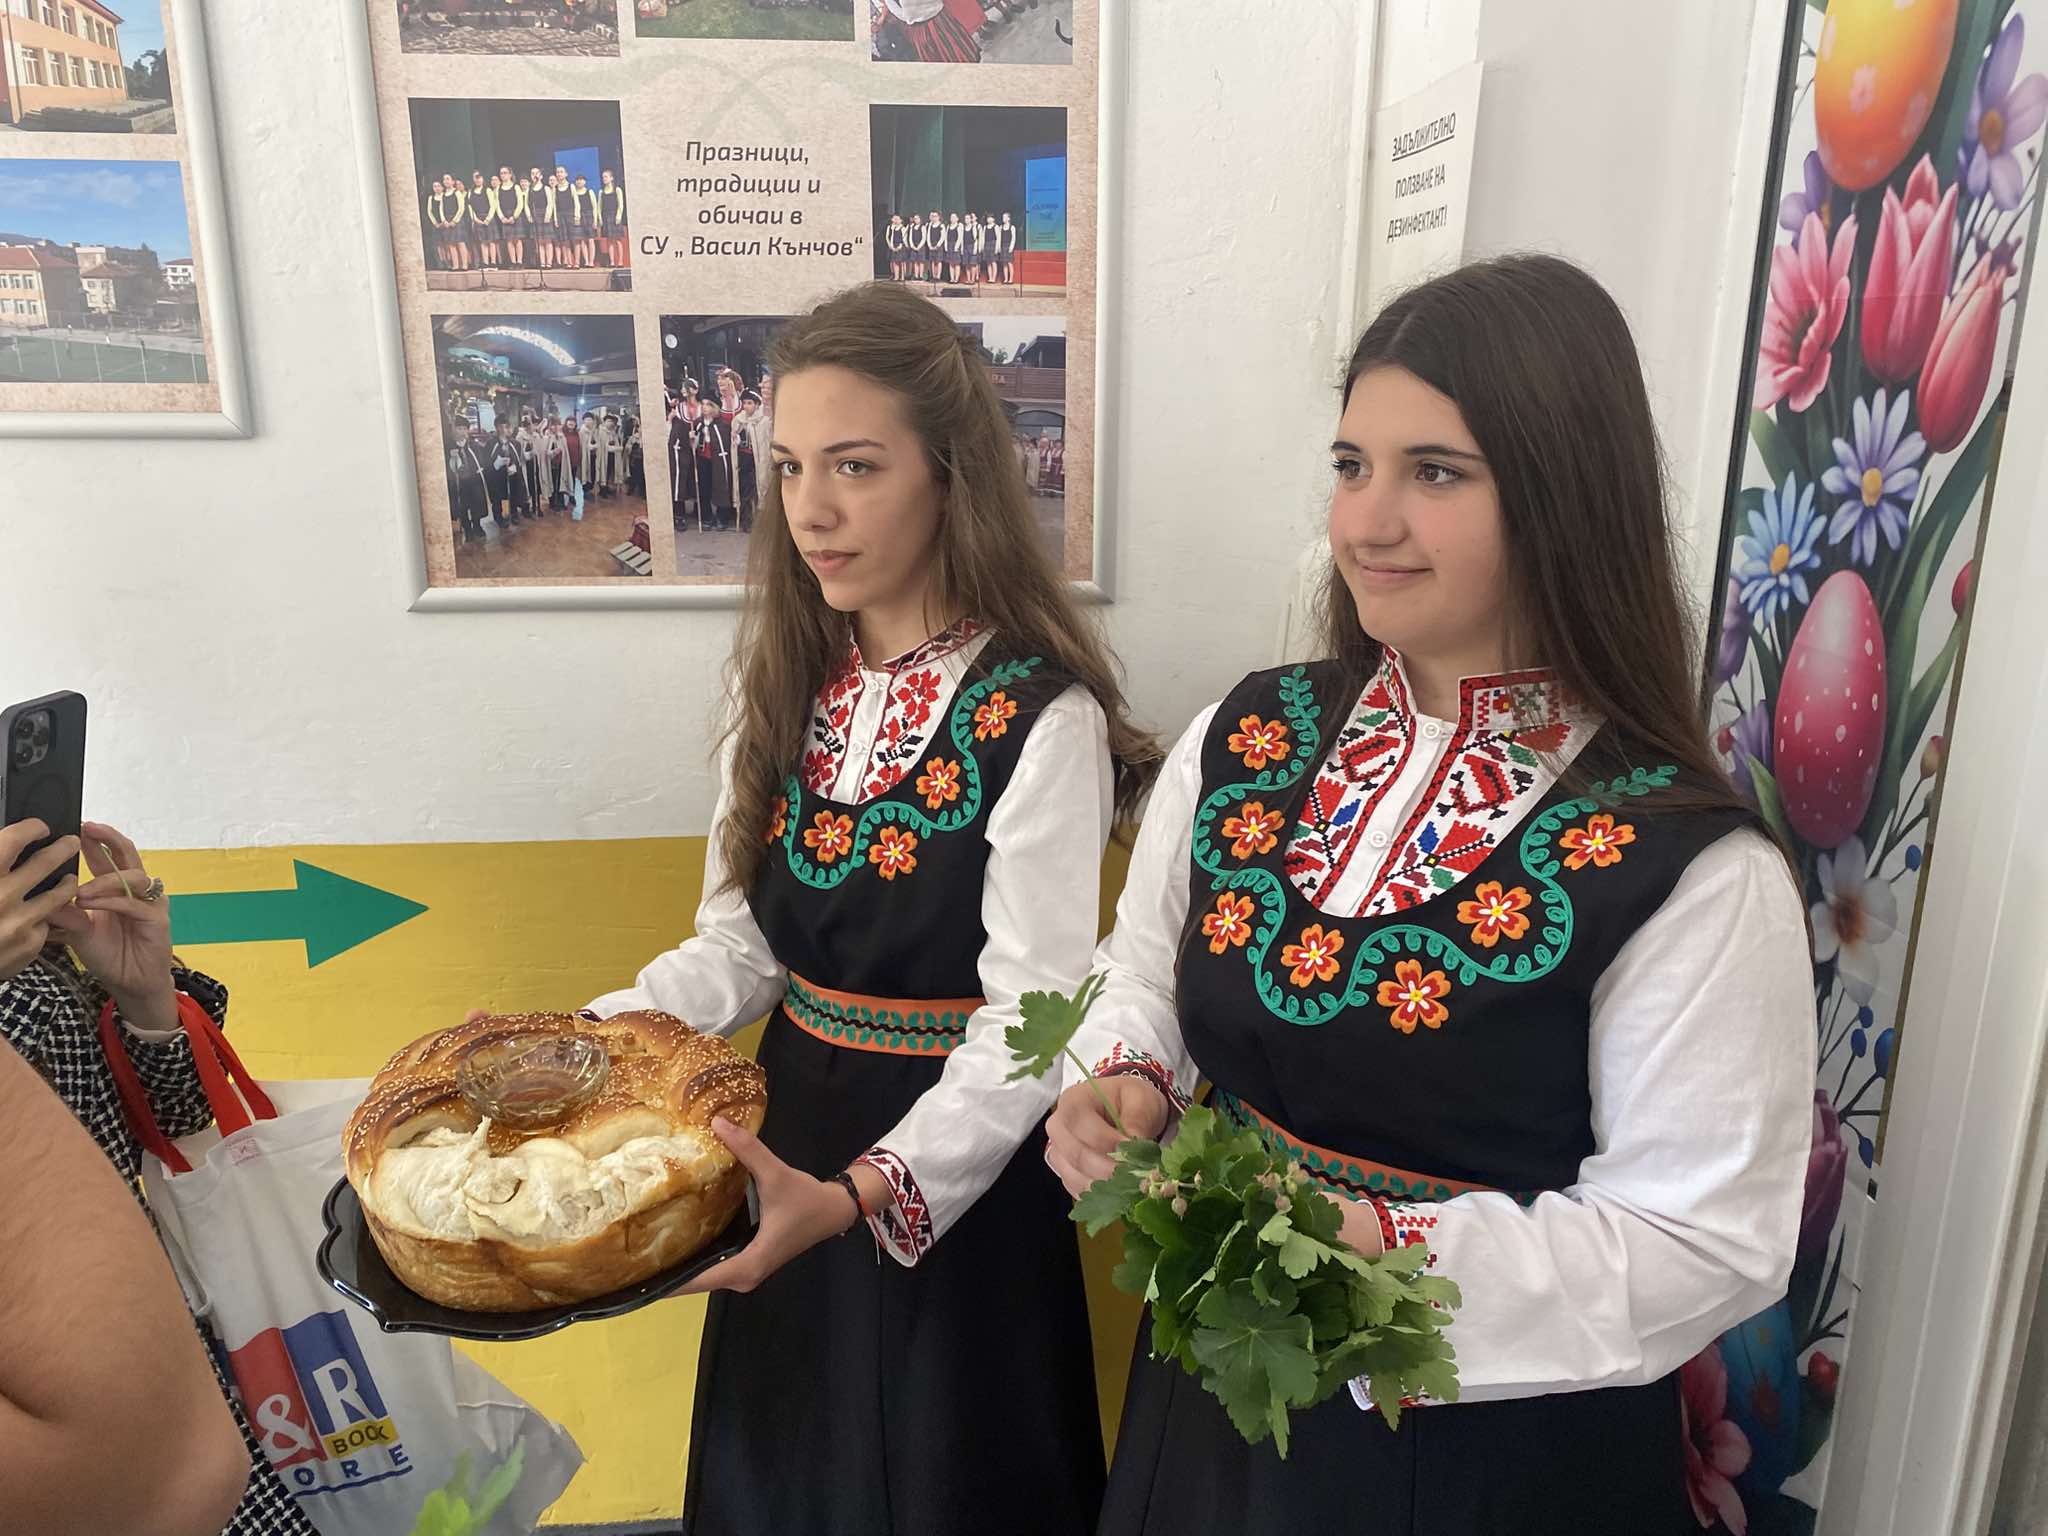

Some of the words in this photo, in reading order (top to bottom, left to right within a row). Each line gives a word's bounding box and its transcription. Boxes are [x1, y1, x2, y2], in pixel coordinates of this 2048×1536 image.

[686, 141, 809, 166] Празници,
[676, 173, 801, 197] традиции
[808, 179, 821, 193] и
[1395, 168, 1433, 199] ПОЛЗВАНЕ
[1434, 163, 1446, 187] НА
[698, 205, 783, 224] обичаи
[790, 210, 803, 224] в
[1386, 204, 1448, 244] ДЕЗИНФЕКТАНТ!
[640, 236, 669, 255] СУ
[691, 236, 760, 256] Васил
[767, 236, 864, 256] Кънчов“
[333, 1425, 390, 1454] BOOK
[294, 1443, 409, 1486] ORE
